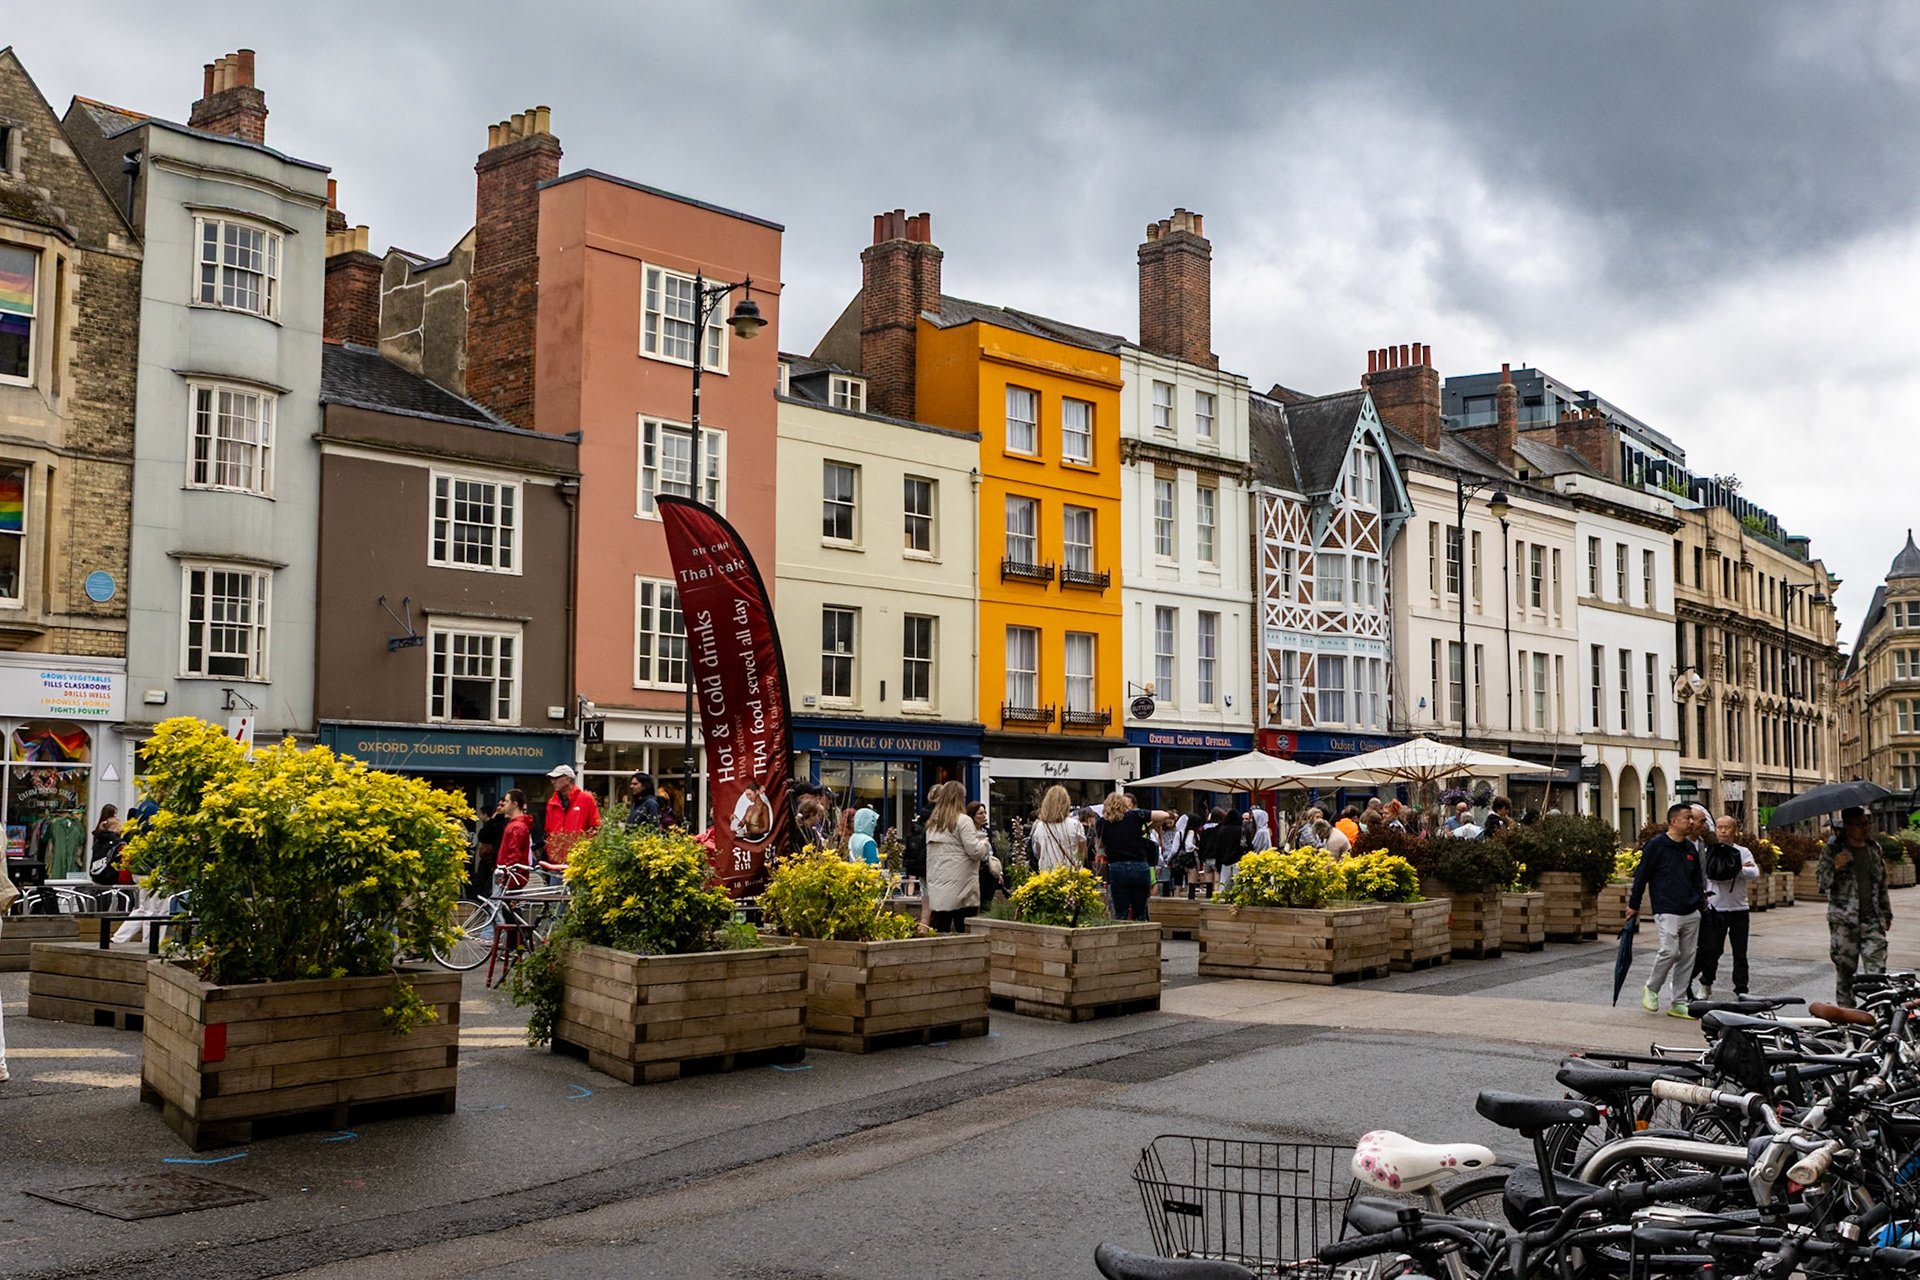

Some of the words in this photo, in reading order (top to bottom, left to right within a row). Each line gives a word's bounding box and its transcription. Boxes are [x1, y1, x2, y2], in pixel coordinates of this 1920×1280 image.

[680, 564, 714, 583] Thai
[717, 558, 747, 575] cafe
[733, 598, 750, 625] day
[693, 610, 719, 667] drinks
[735, 629, 752, 646] all
[69, 674, 112, 682] VEGETABLES
[739, 650, 760, 695] served
[63, 682, 111, 691] CLASSROOMS
[64, 690, 87, 698] DRILLS
[702, 673, 726, 716] Cold
[40, 698, 80, 706] EMPOWERS
[82, 699, 111, 708] WOMEN
[765, 675, 780, 719] takeaway
[50, 706, 76, 714] FIGHTS
[746, 700, 765, 735] food
[590, 722, 598, 738] K
[711, 723, 730, 738] &
[770, 721, 779, 730] &
[358, 741, 409, 754] OXFORD
[413, 743, 462, 755] TOURIST
[467, 745, 544, 757] INFORMATION
[818, 734, 877, 749] HERITAGE
[879, 737, 895, 749] OF
[896, 738, 941, 751] OXFORD
[1330, 738, 1356, 751] Oxford
[717, 744, 735, 783] Hot
[738, 756, 746, 779] THAI
[753, 740, 767, 779] THAI
